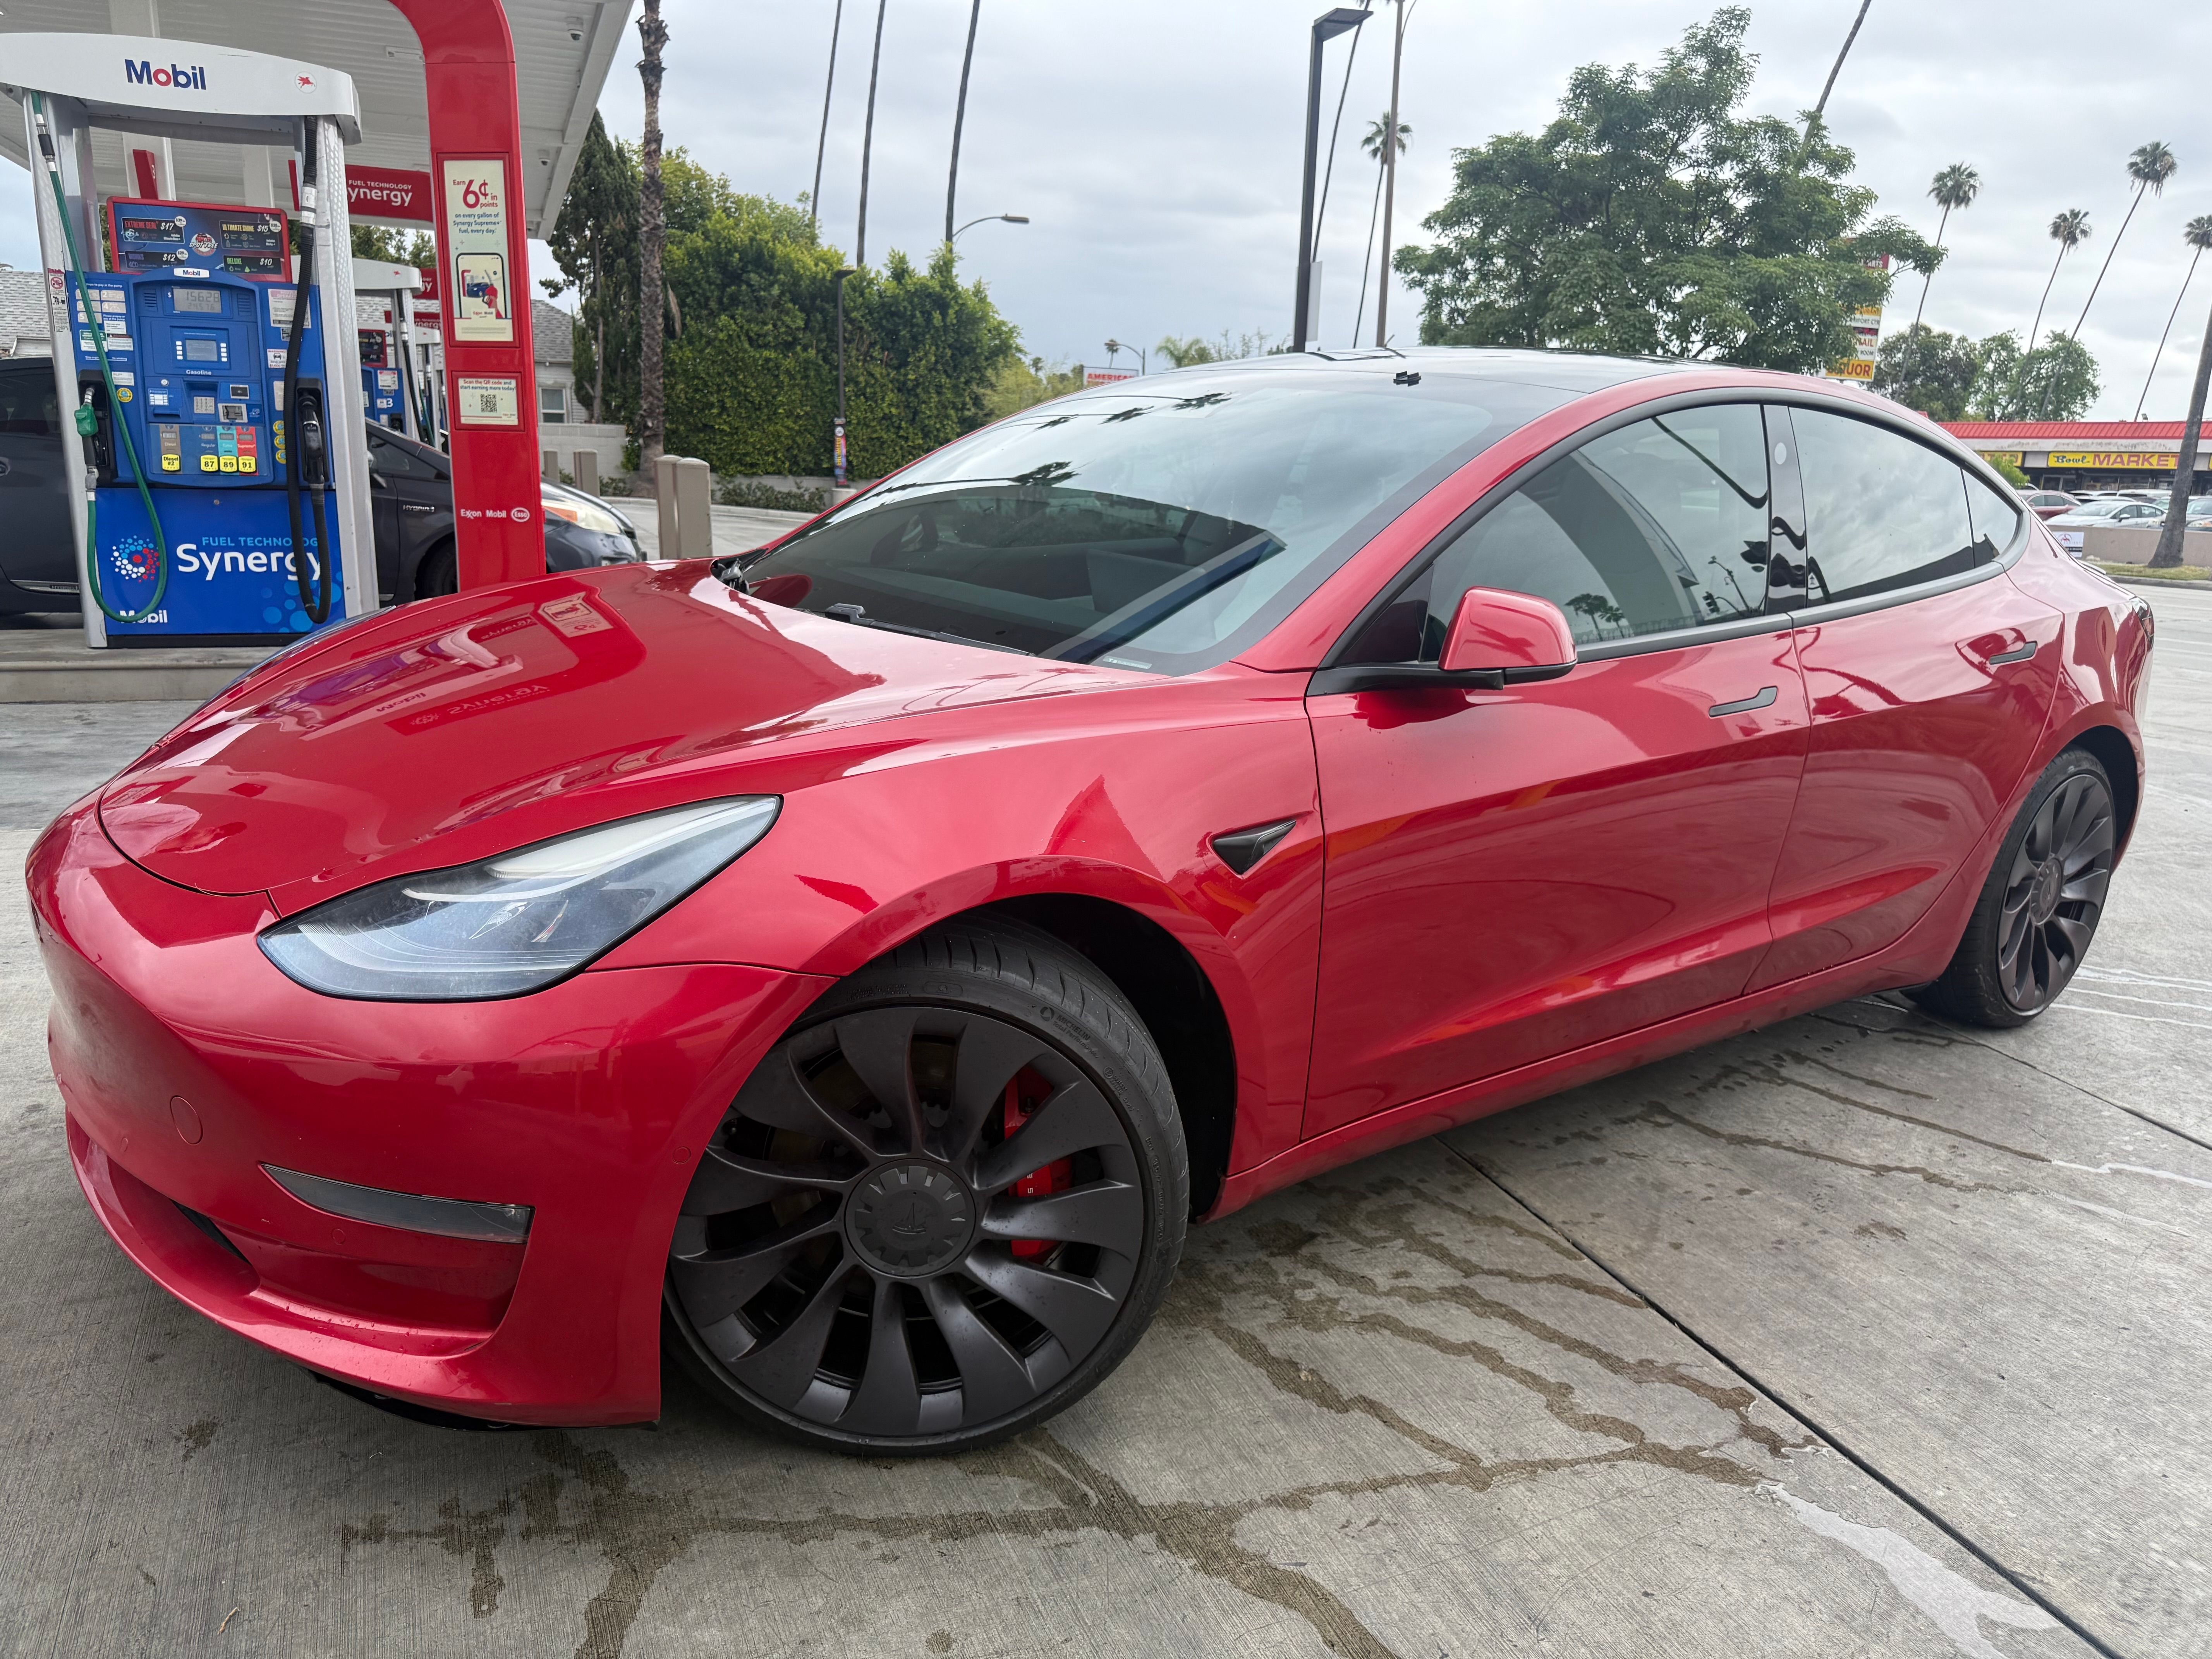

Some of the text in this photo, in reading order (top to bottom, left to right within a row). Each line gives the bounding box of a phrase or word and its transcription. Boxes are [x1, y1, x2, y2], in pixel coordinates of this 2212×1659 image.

[125, 59, 206, 90] Mobil
[367, 181, 412, 190] TECHNOLOGY
[347, 187, 412, 206] ynergy
[480, 201, 498, 209] points
[2053, 455, 2090, 464] Bowl
[460, 509, 482, 519] Exxon
[486, 509, 507, 518] Mobil
[202, 537, 318, 546] FUEL TECHNOOG
[1053, 1021, 1067, 1032] Total
[1057, 1015, 1091, 1041] MICHELIN
